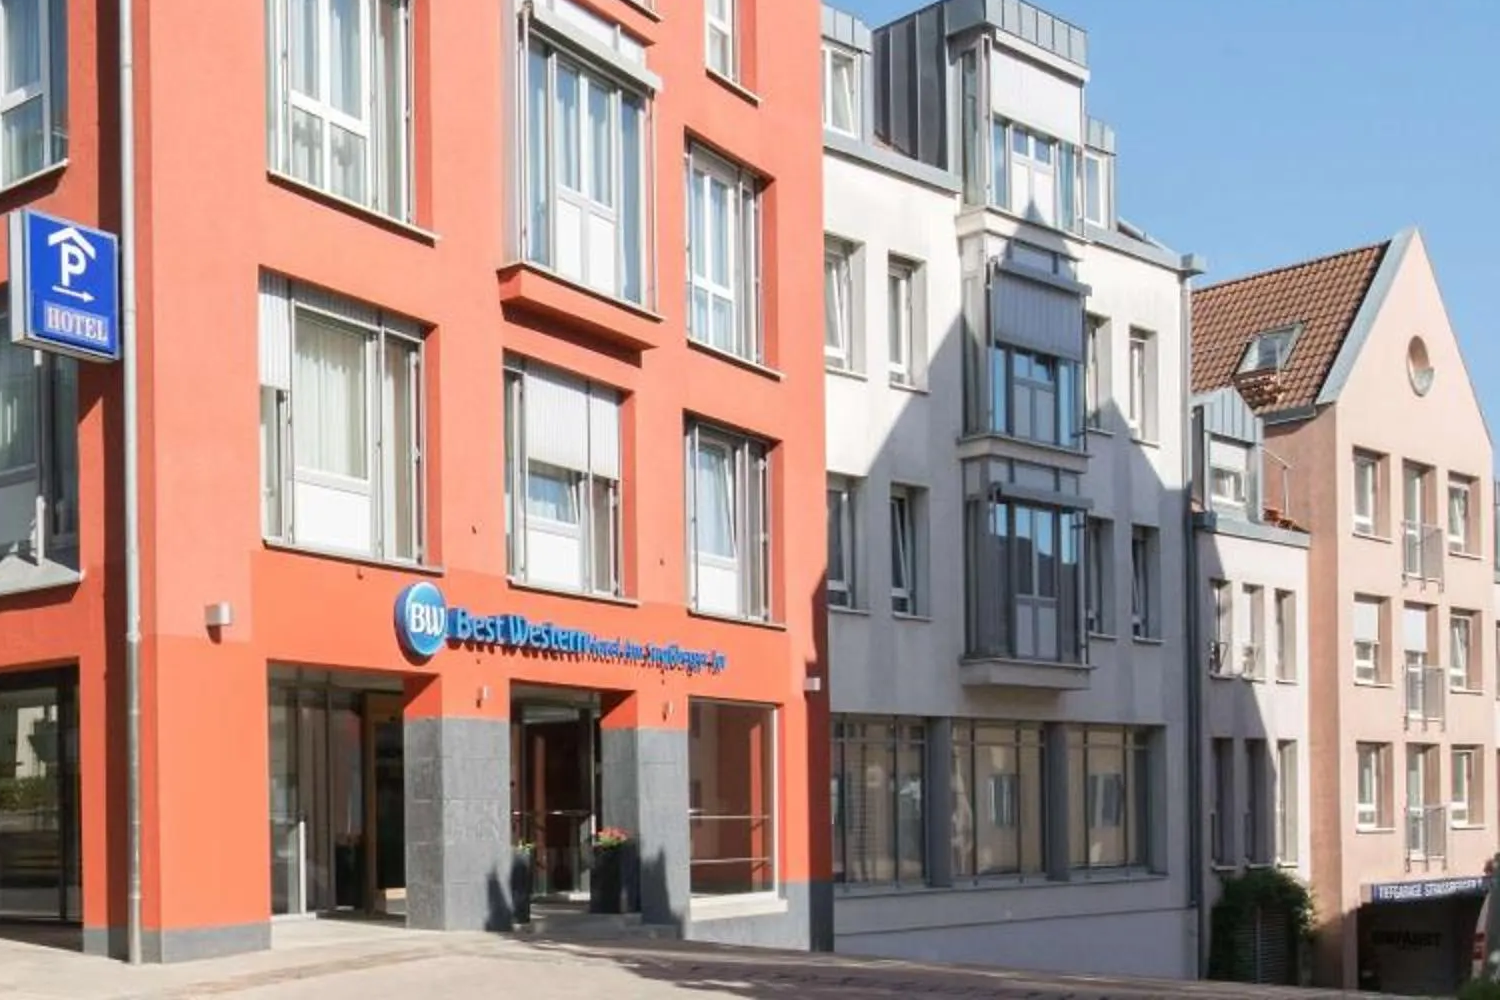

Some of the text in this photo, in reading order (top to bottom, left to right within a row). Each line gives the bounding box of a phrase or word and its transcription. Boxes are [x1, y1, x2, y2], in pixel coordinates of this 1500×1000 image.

[61, 243, 87, 287] P
[48, 306, 107, 341] HOTEL
[410, 603, 444, 636] BW
[456, 608, 505, 645] Best
[508, 614, 588, 653] Western
